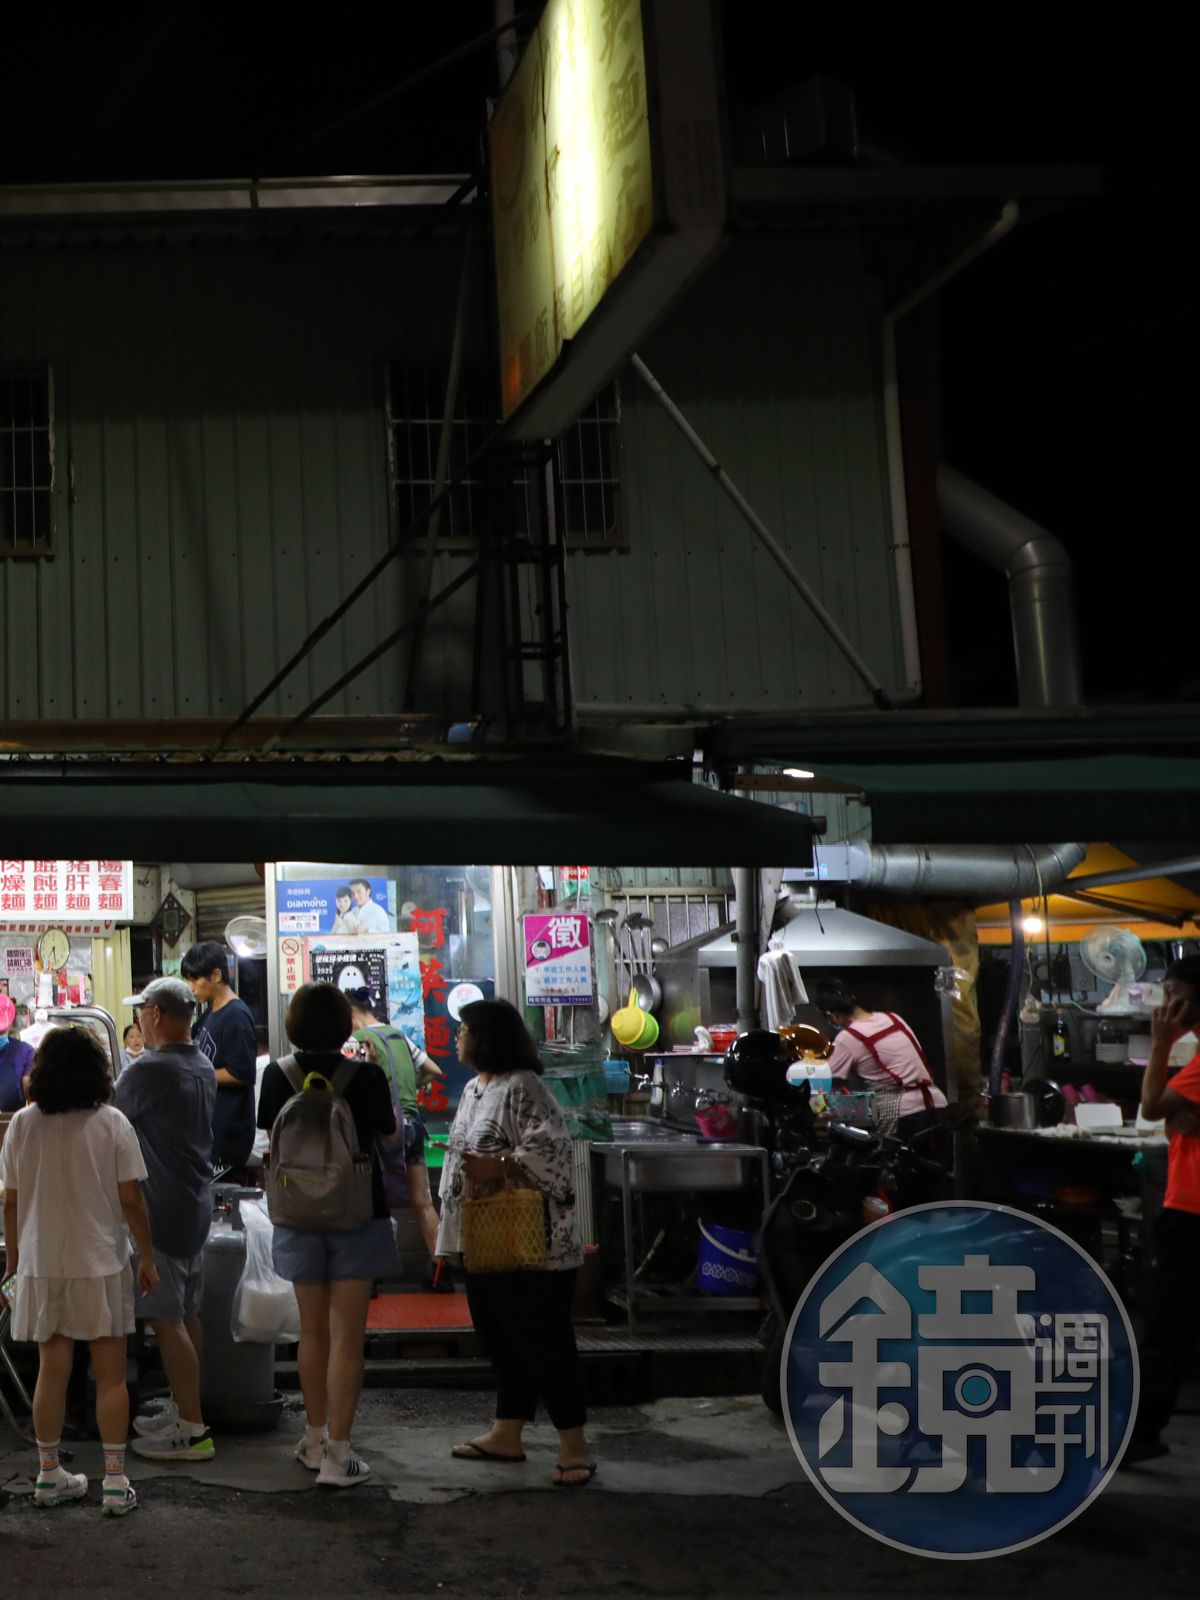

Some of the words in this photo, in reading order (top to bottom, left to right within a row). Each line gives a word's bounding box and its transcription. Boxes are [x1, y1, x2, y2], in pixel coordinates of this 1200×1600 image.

[1, 860, 26, 911] 肉燥麵
[65, 860, 90, 911] 豬肝麵
[97, 860, 123, 911] 陽春麵
[548, 916, 584, 949] 徵
